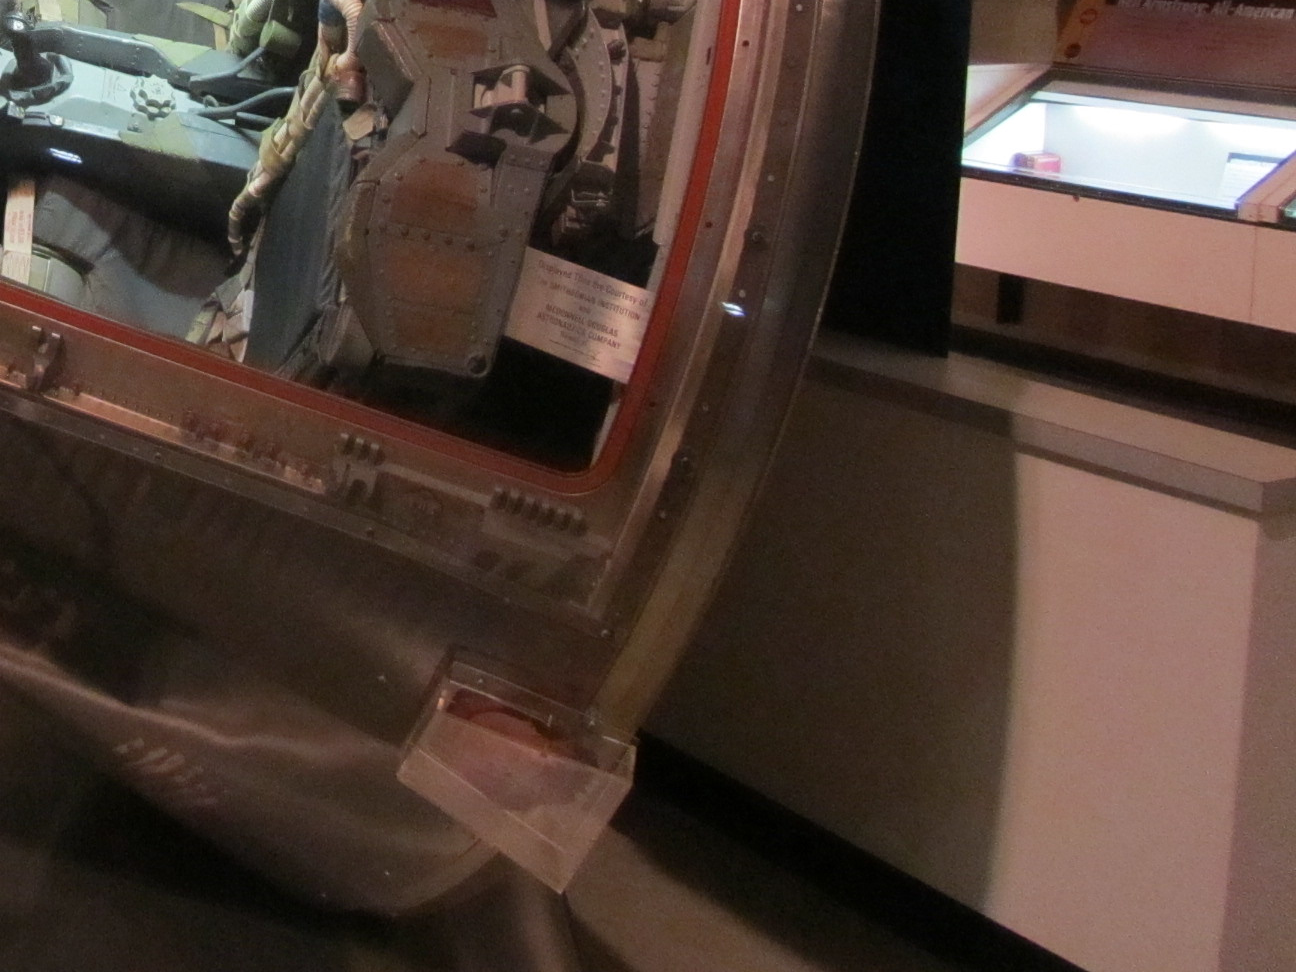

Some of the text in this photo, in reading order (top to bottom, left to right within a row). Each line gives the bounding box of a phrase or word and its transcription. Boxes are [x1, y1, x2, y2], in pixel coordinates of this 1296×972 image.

[605, 284, 636, 304] Courtesy
[597, 298, 641, 321] INSTITUTION
[587, 331, 621, 349] COMPANY
